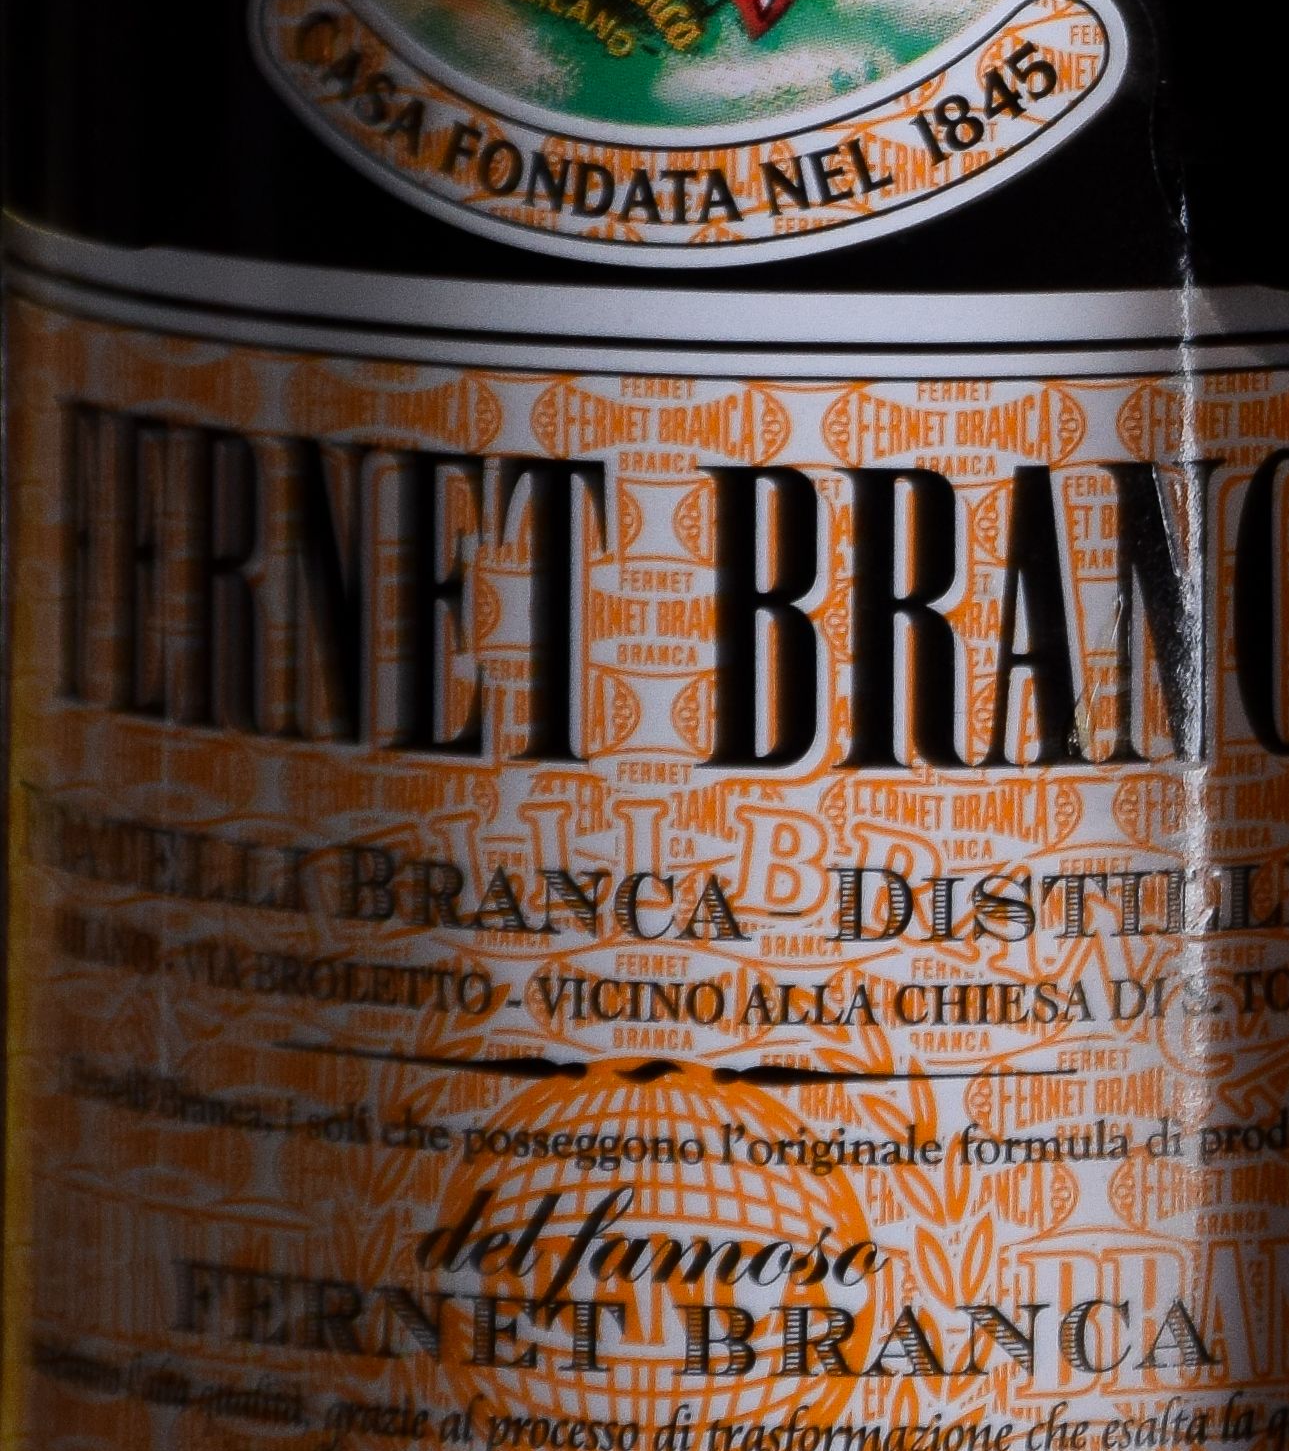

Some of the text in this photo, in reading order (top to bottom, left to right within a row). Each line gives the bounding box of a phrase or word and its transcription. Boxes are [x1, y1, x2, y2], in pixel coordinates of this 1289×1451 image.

[291, 9, 1058, 224] CASA FONDATA NEL 1845
[21, 781, 313, 912] ATELLI
[330, 842, 752, 941] BRANCA
[254, 946, 494, 1017] BROLETTO
[531, 976, 727, 1026] VICINO
[739, 981, 880, 1028] ALLA
[893, 981, 1093, 1028] CHIESA
[1108, 978, 1168, 1022] DI
[381, 1110, 451, 1153] che
[461, 1125, 705, 1173] posseggono
[721, 1121, 942, 1176] l'originale
[958, 1118, 1129, 1169] formula
[1146, 1116, 1185, 1158] di
[418, 1185, 890, 1314] del famoso
[171, 1258, 626, 1373] FERNET
[672, 1297, 1224, 1379] BRANCA
[439, 1399, 476, 1444] al
[1101, 1400, 1209, 1450] esalta
[1220, 1390, 1256, 1442] la
